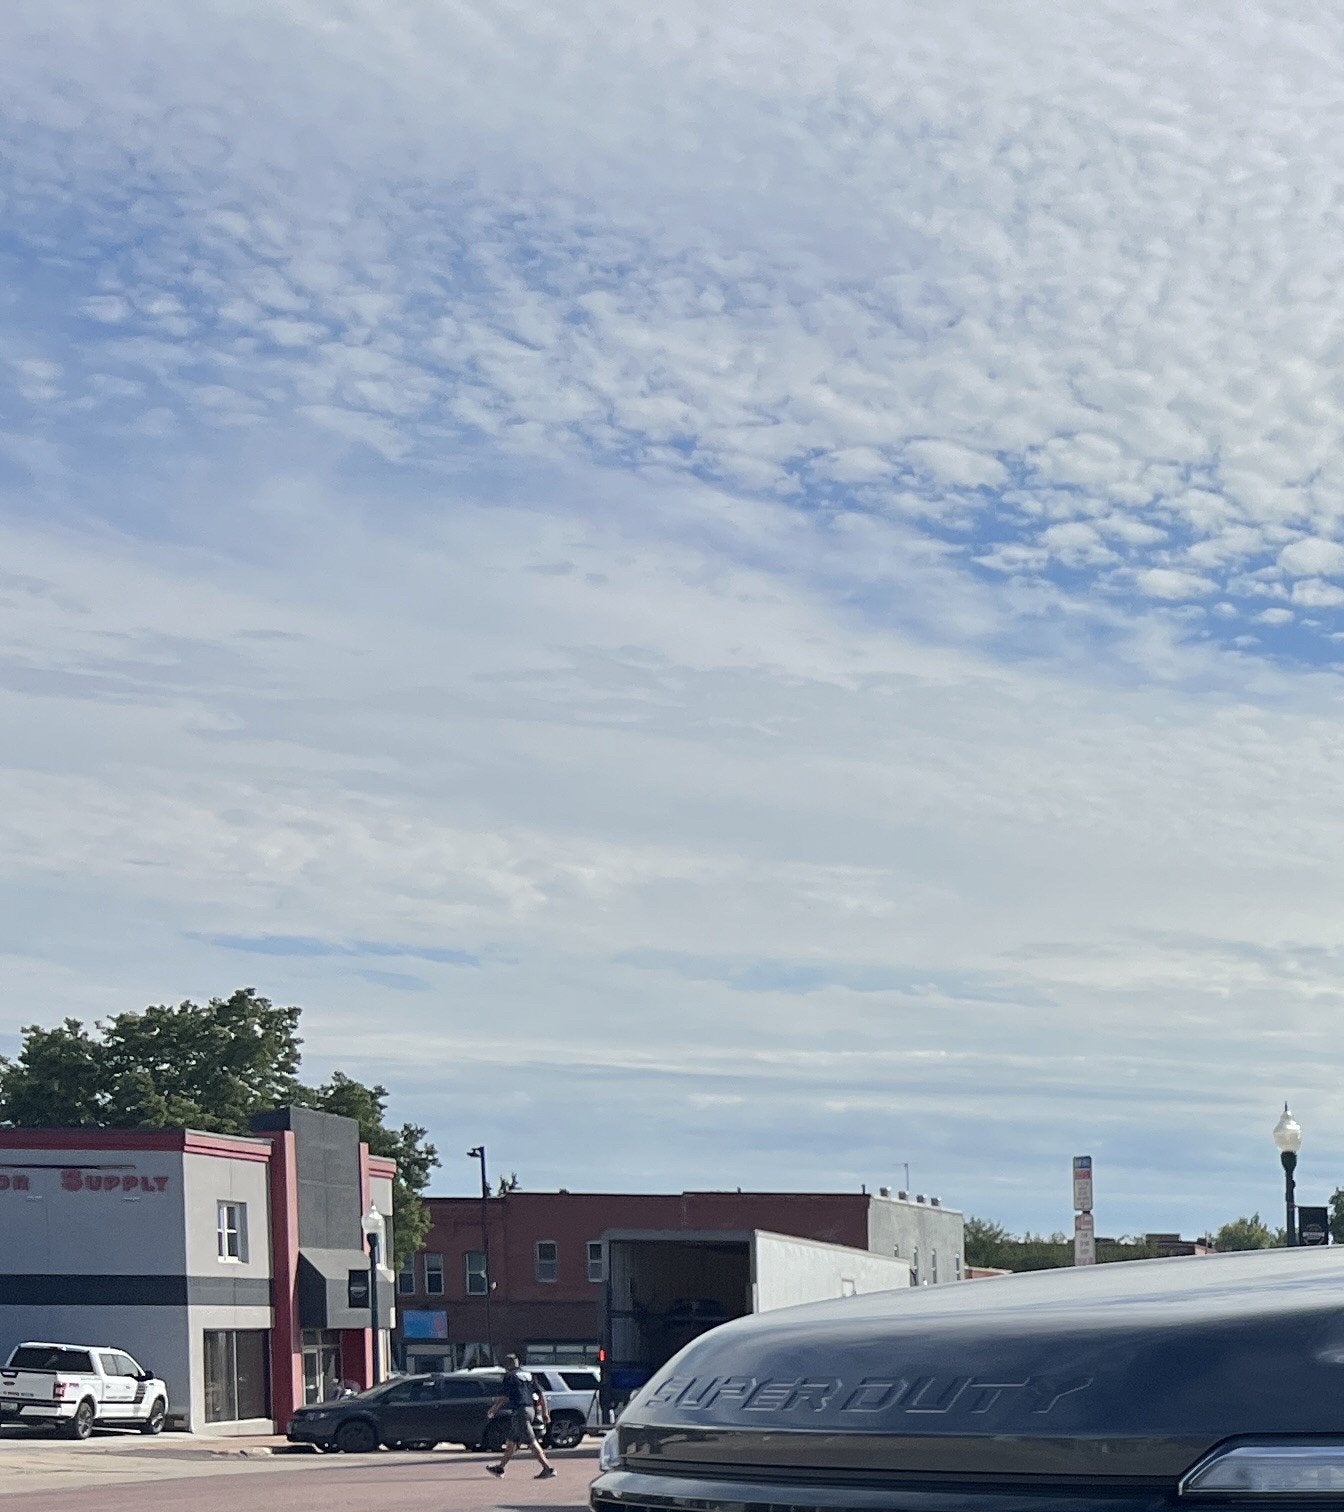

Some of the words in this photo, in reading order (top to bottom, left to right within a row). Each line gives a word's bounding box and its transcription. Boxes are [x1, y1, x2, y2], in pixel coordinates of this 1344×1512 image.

[61, 1169, 169, 1192] SUPPLY
[645, 1376, 841, 1412] SUPER
[842, 1376, 1095, 1414] DUTY
